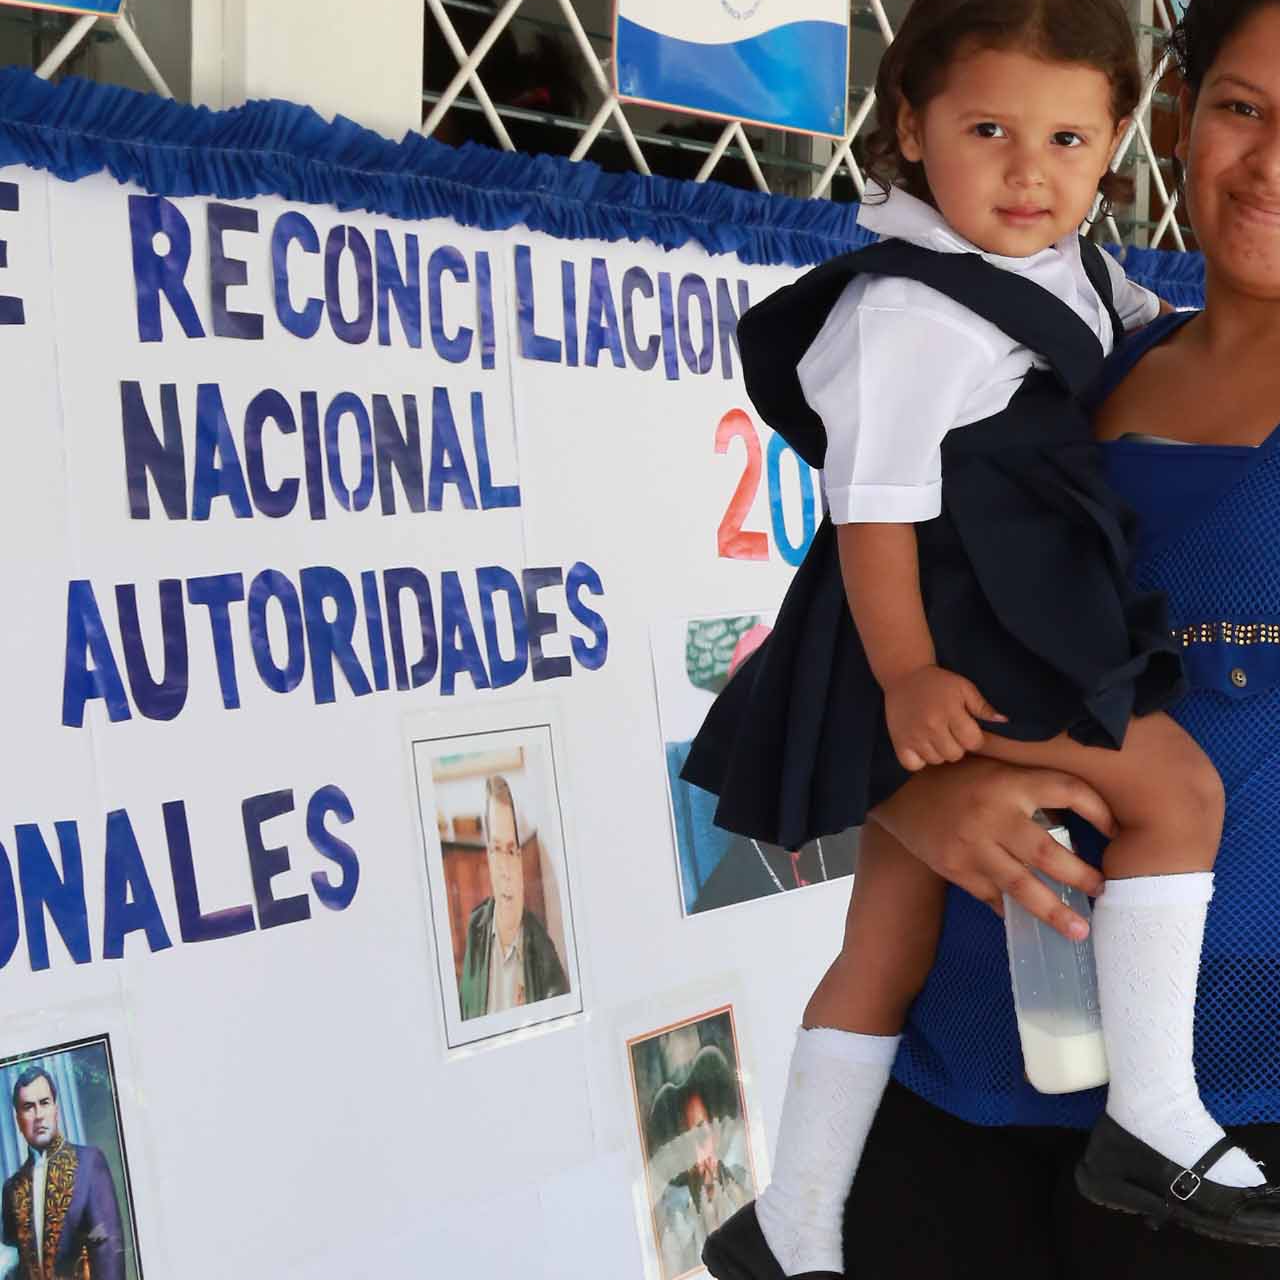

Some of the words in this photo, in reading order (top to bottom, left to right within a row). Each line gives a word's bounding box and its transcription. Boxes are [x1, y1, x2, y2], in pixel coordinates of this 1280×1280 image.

[120, 380, 522, 521] NACIONAL
[713, 407, 830, 568] 20
[62, 561, 608, 728] AUTORIDADES
